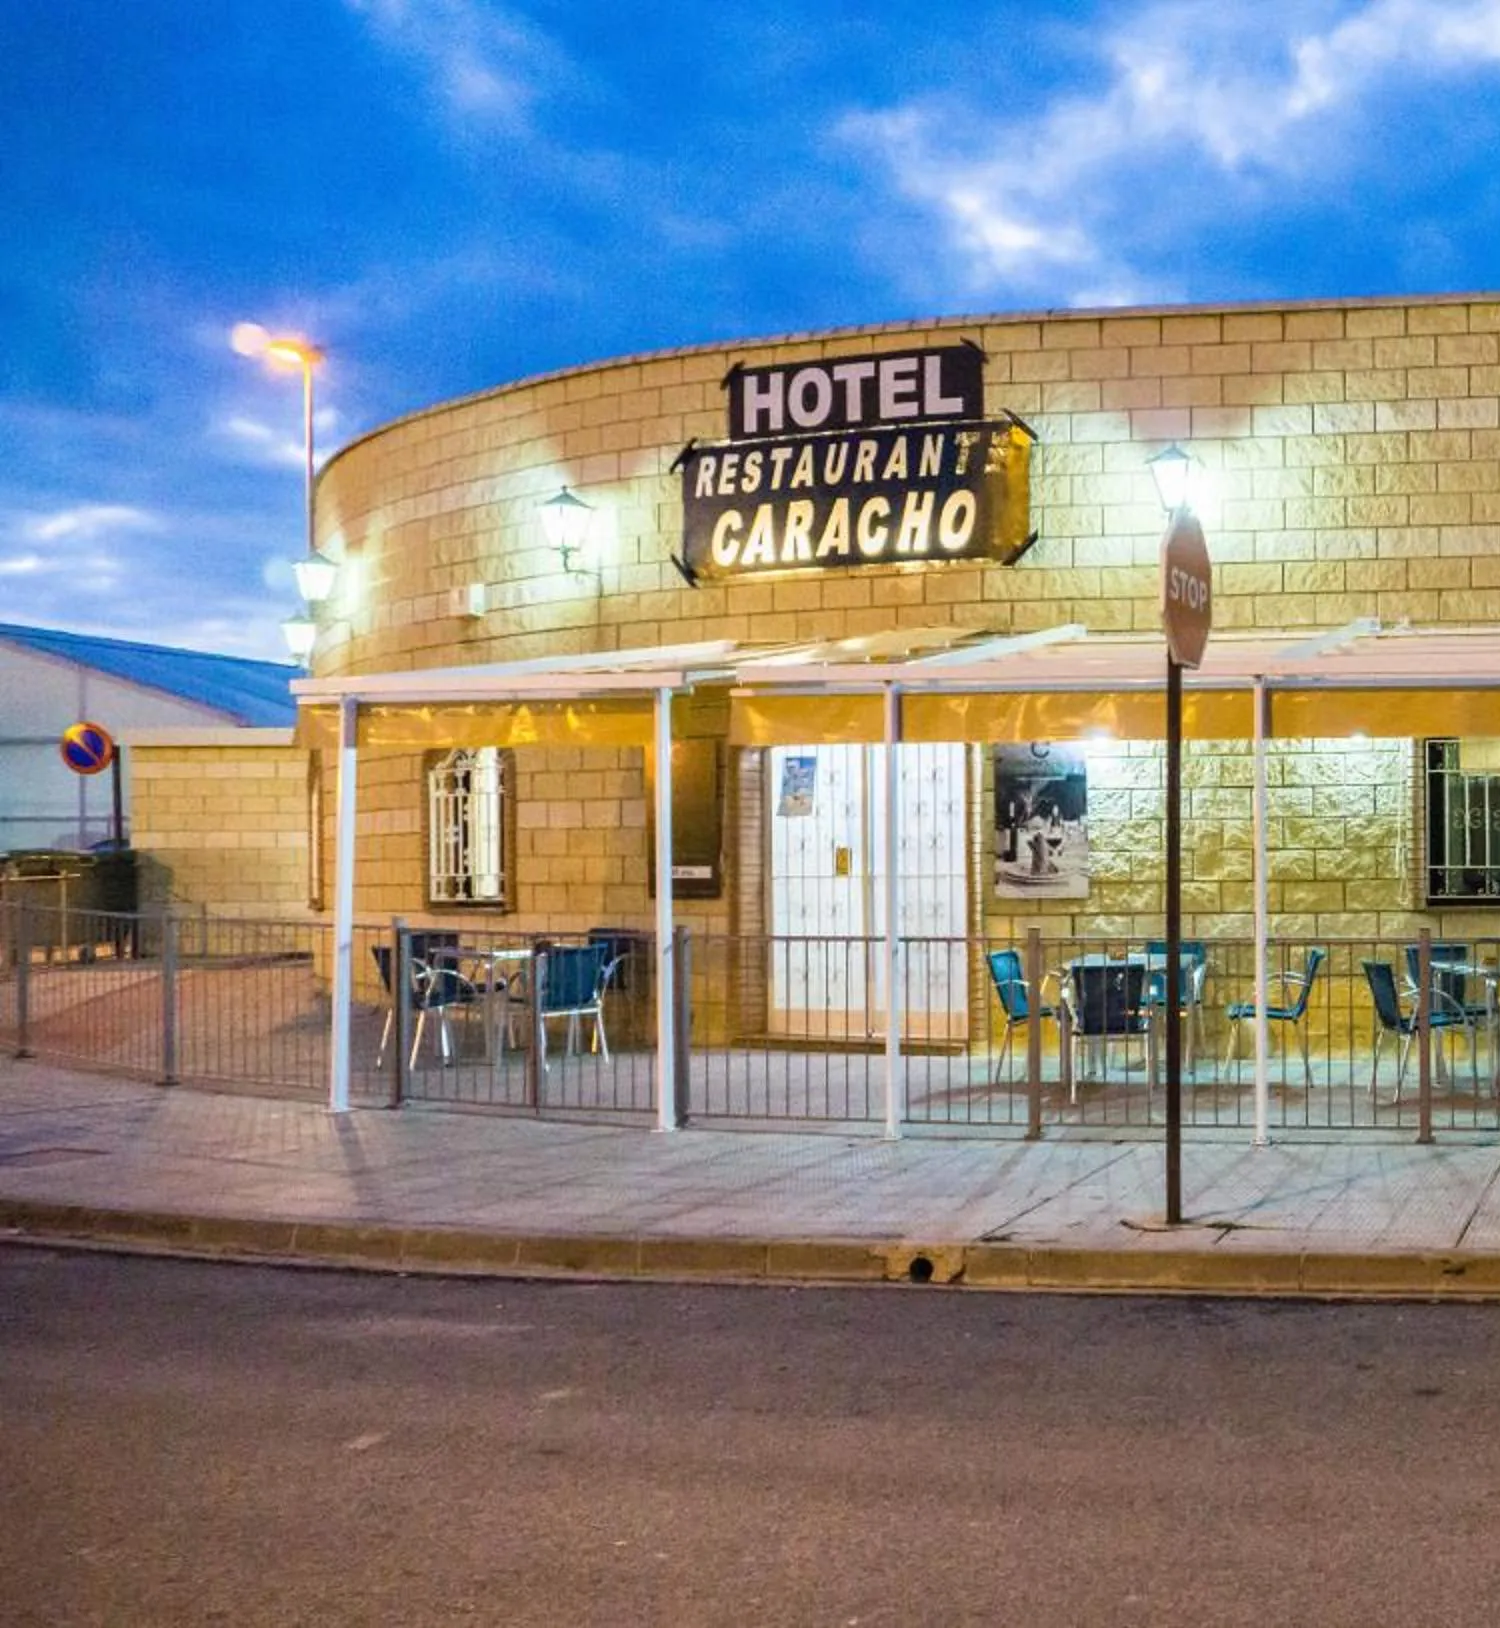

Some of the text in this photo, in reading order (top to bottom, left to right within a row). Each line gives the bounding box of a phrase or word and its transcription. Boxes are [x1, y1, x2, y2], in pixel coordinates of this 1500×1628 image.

[743, 355, 964, 433] HOTEL
[711, 489, 977, 567] CARACHO
[1170, 566, 1207, 612] STOP
